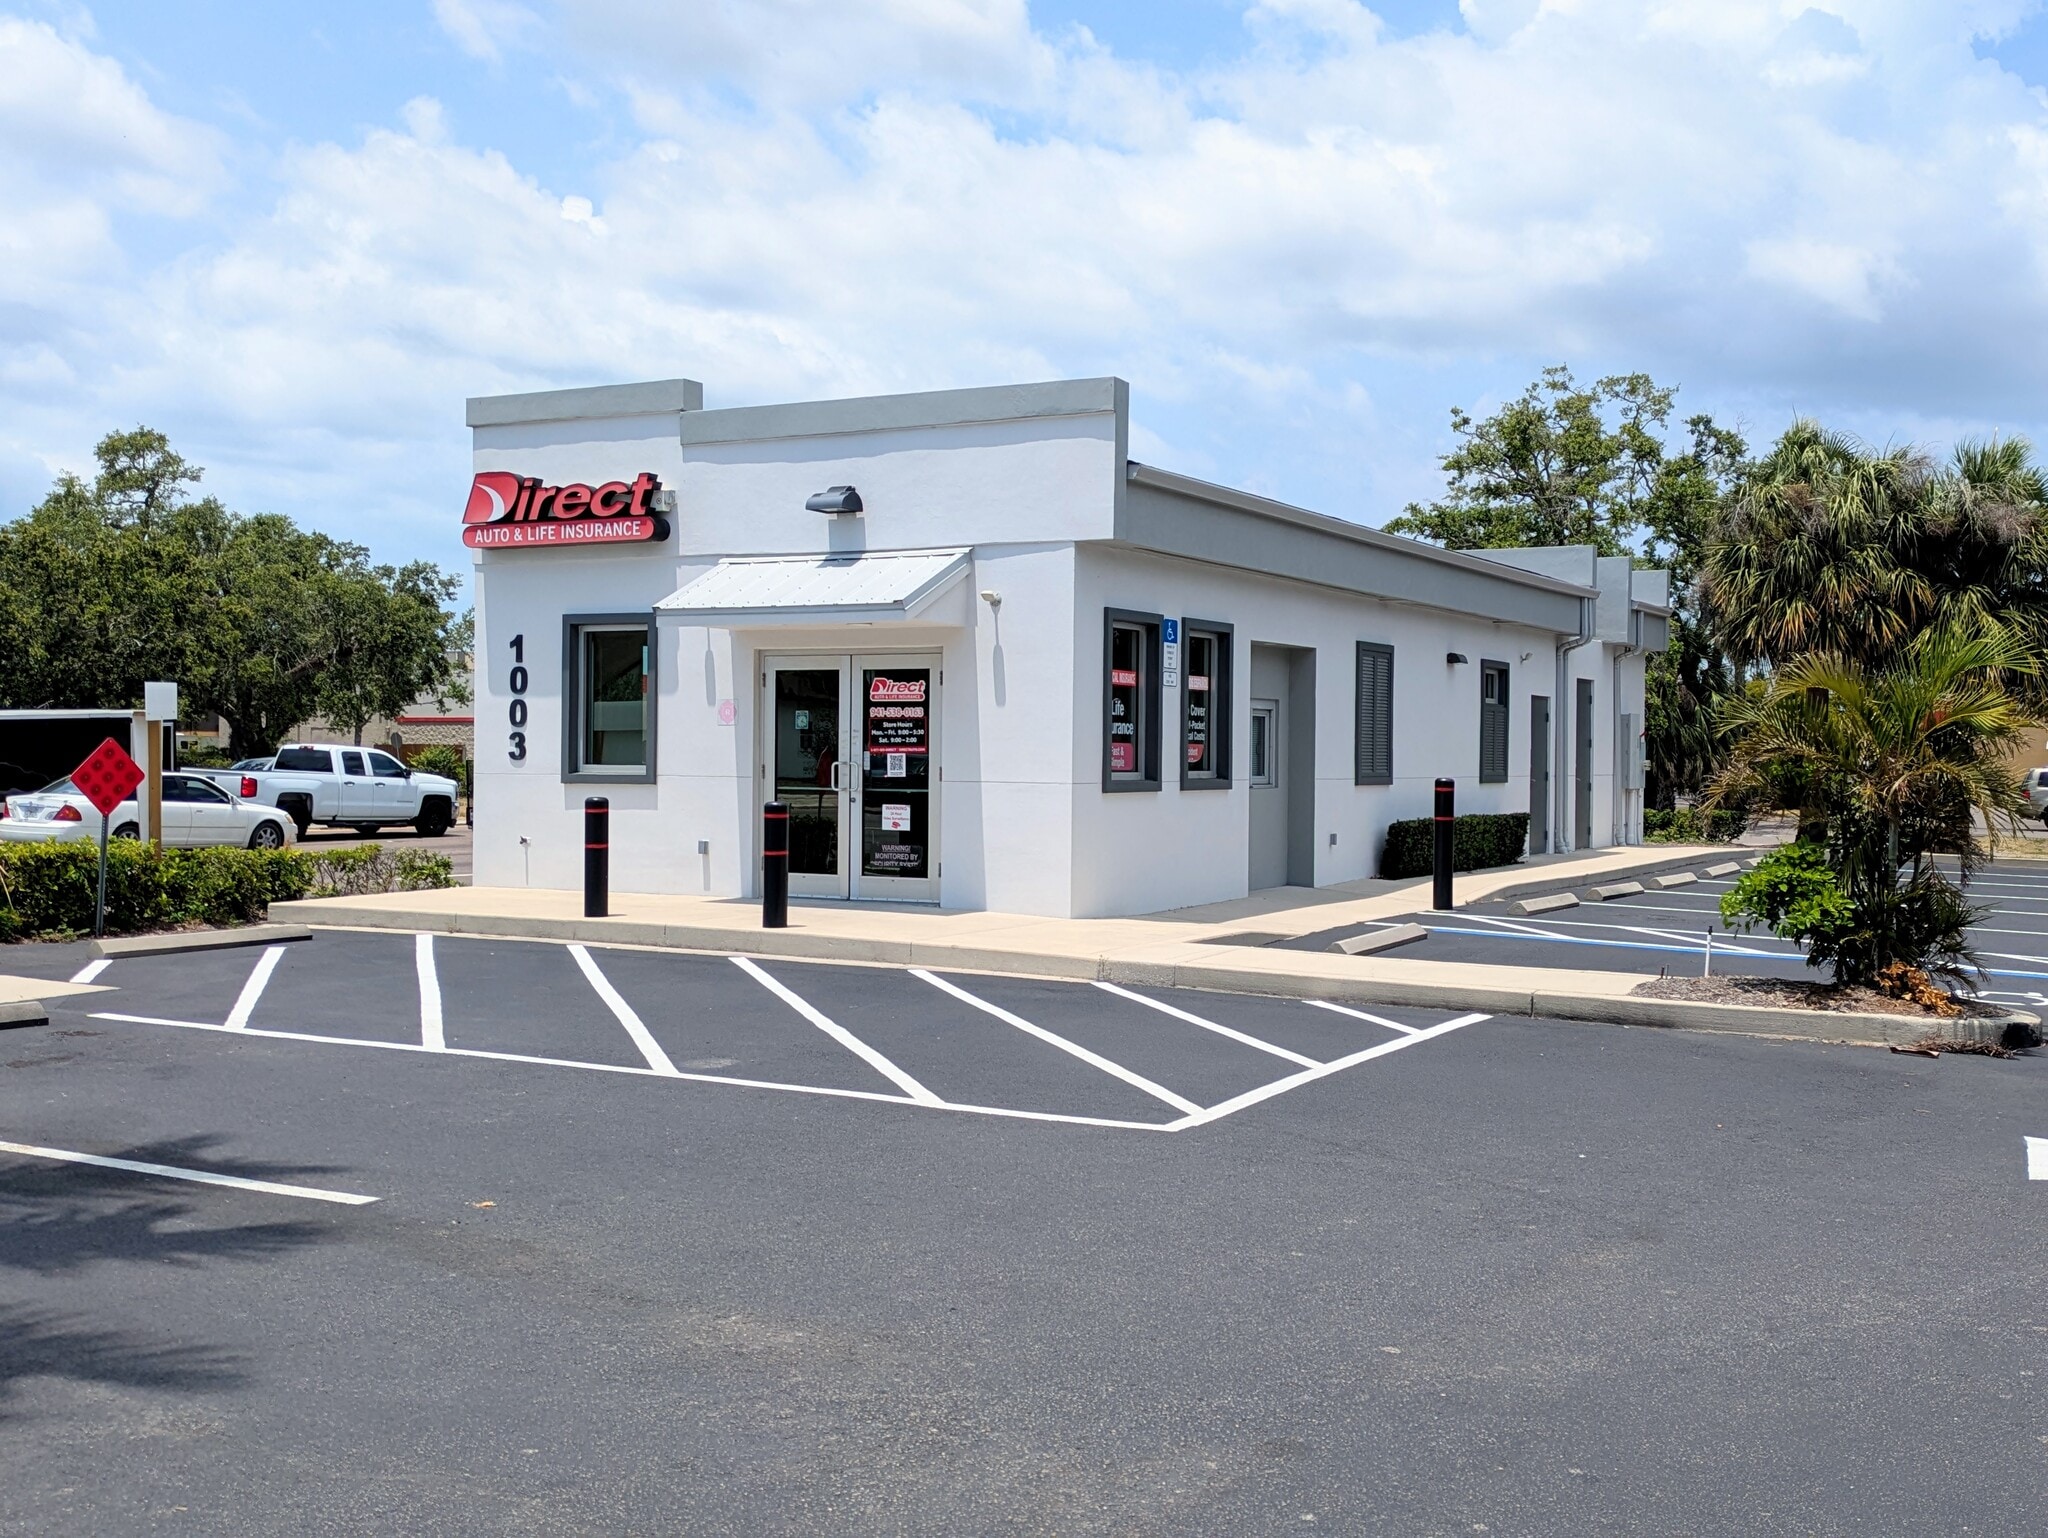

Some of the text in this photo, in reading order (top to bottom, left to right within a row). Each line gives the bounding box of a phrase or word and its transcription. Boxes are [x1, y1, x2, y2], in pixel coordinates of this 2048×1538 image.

[462, 472, 655, 524] Direct
[475, 521, 641, 543] AUTO & LIFE INSURANCE
[871, 678, 925, 693] Direct
[870, 707, 924, 717] 941-538-0163
